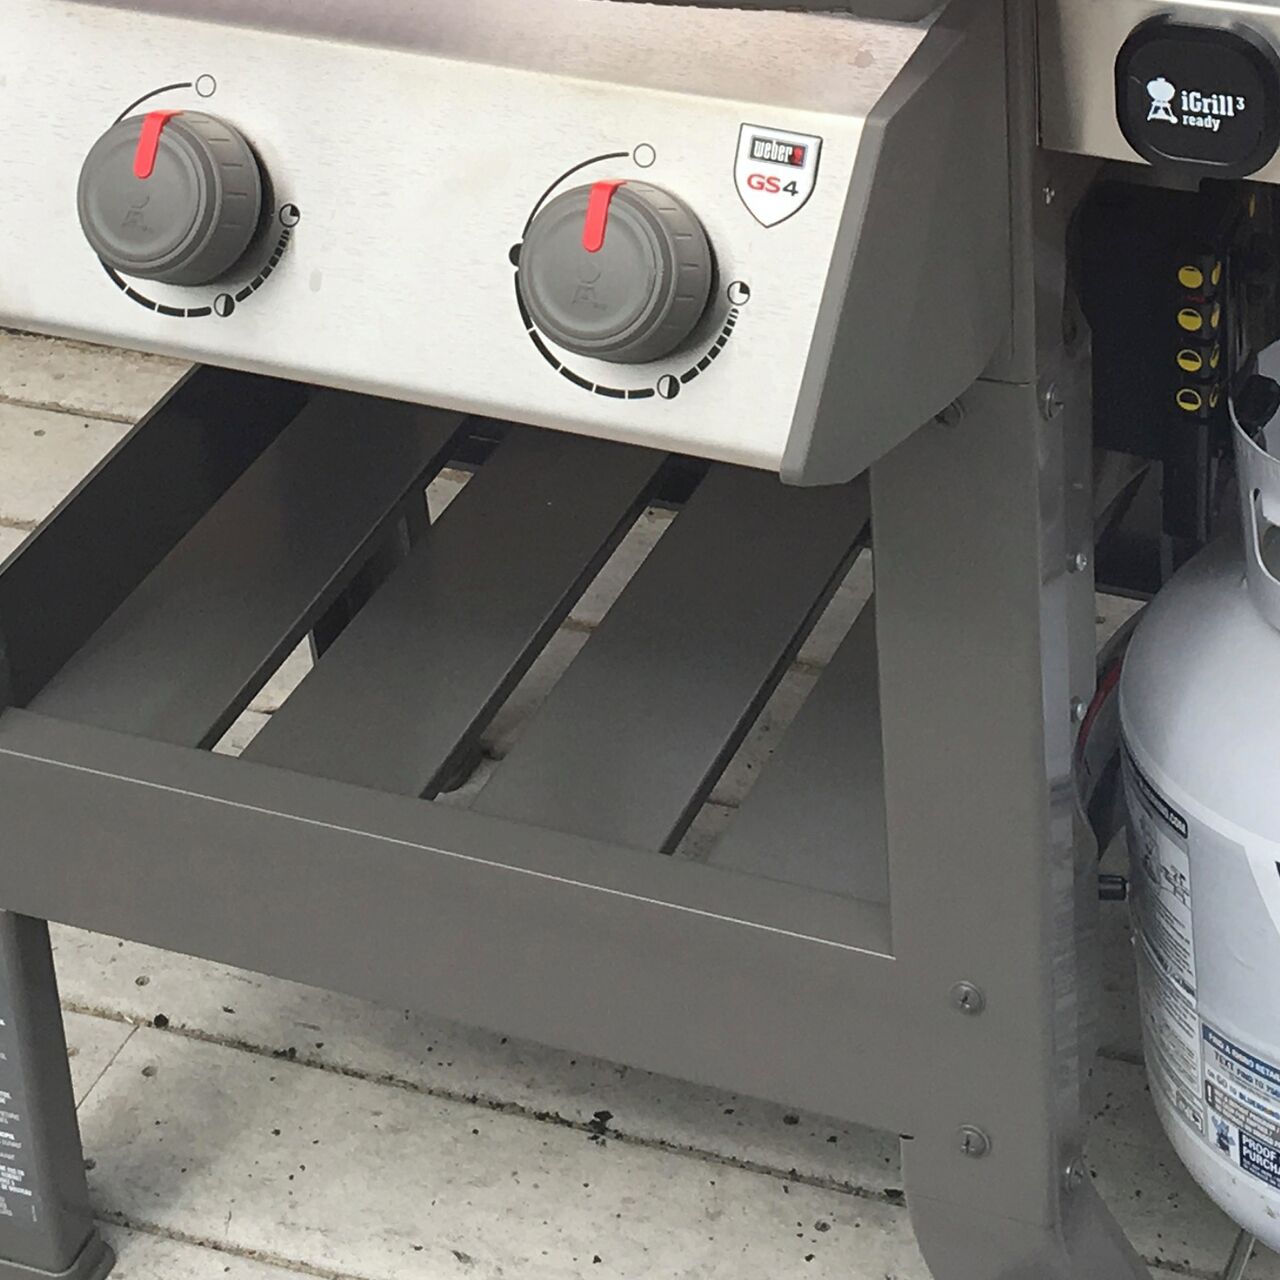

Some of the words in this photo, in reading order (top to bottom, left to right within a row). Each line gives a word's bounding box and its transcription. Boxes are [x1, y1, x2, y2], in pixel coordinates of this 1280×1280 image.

[1182, 115, 1221, 132] ready
[753, 139, 794, 163] weber
[1242, 1134, 1277, 1161] PROOF
